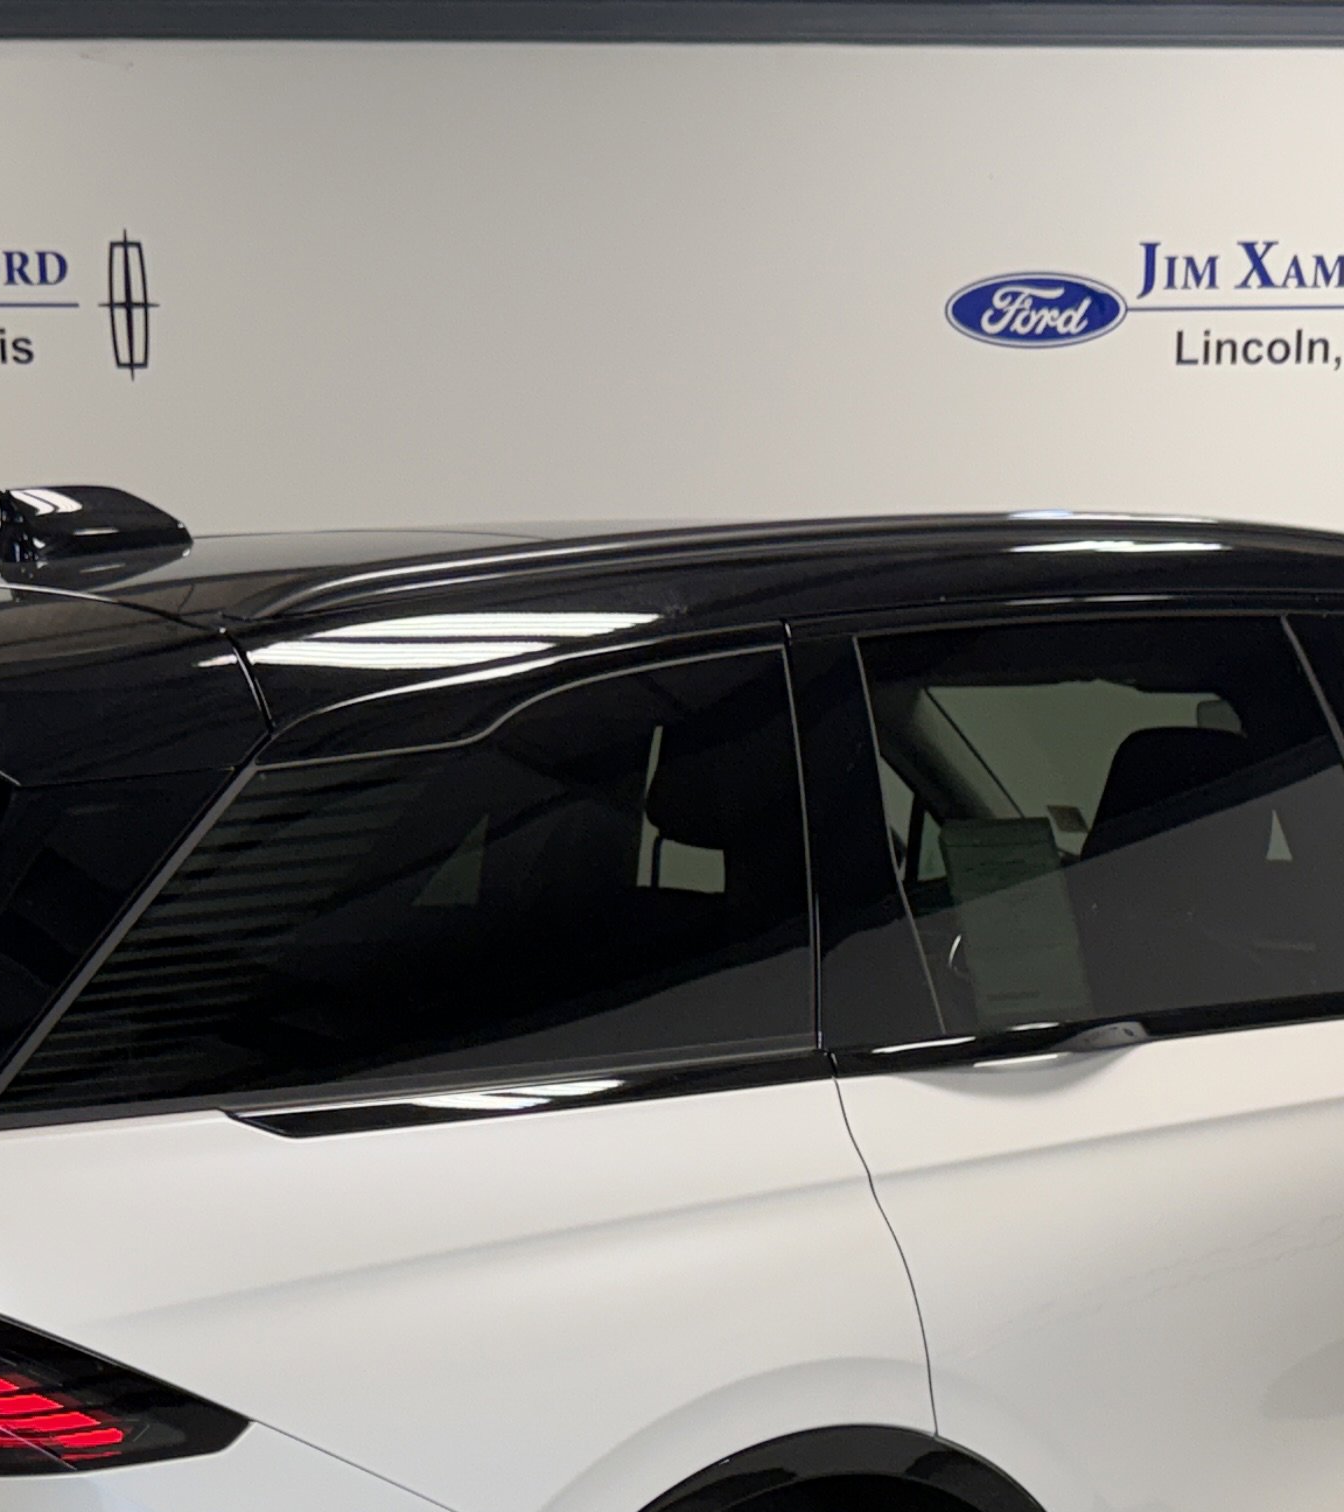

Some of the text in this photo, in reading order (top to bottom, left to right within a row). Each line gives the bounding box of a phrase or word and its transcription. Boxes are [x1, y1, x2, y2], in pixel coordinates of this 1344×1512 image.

[1136, 241, 1218, 299] JIM
[981, 286, 1089, 337] Ford
[1175, 329, 1342, 371] Lincoln,
